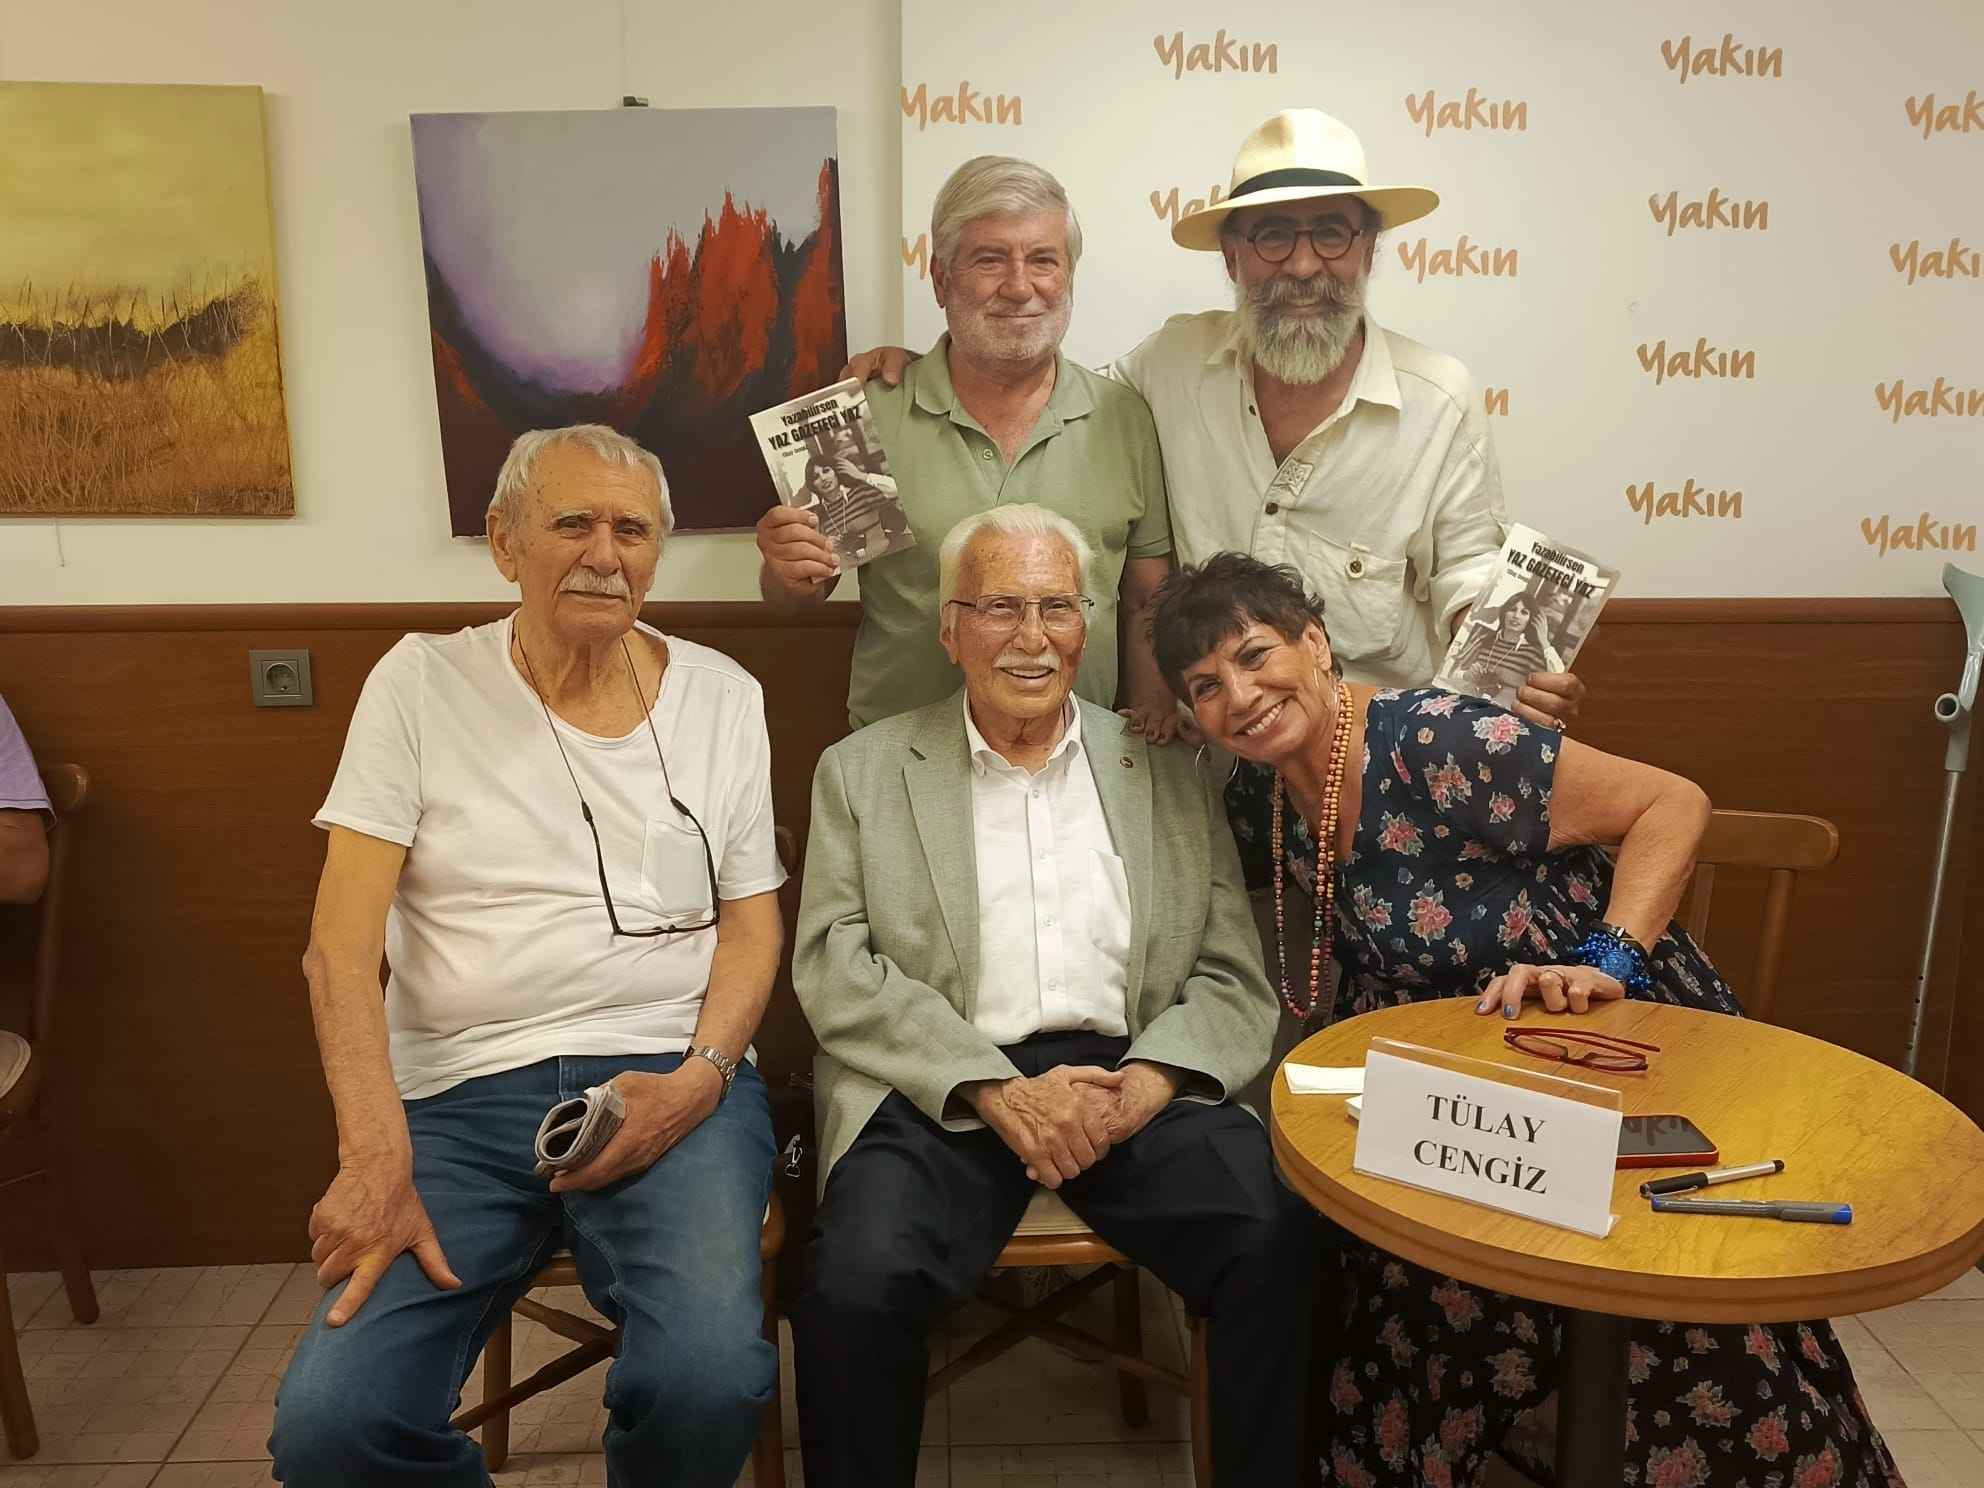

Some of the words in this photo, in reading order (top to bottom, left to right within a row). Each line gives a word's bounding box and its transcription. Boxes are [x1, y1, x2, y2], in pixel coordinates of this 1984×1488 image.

[1154, 29, 1278, 80] Yakın
[1661, 31, 1783, 84] Yakın
[900, 80, 1022, 131] Yakın
[1406, 87, 1528, 137] Yakın
[1905, 90, 1984, 140] Yak
[1647, 188, 1769, 236] Yakın
[1398, 235, 1518, 283] Yakın
[1889, 237, 1984, 285] Yakı
[1636, 337, 1755, 385] Yakın
[768, 432, 791, 450] YAZ
[791, 411, 840, 441] GAZETECİ
[840, 405, 862, 423] YAZ
[1625, 478, 1743, 524] Yakın
[1860, 511, 1977, 557] Yakın
[1507, 548, 1528, 569] YAZ
[1526, 558, 1576, 588] GAZETECİ
[1574, 578, 1596, 599] YAZ
[1426, 1094, 1547, 1143] TÜLAY
[1414, 1140, 1548, 1194] CENGİZ
